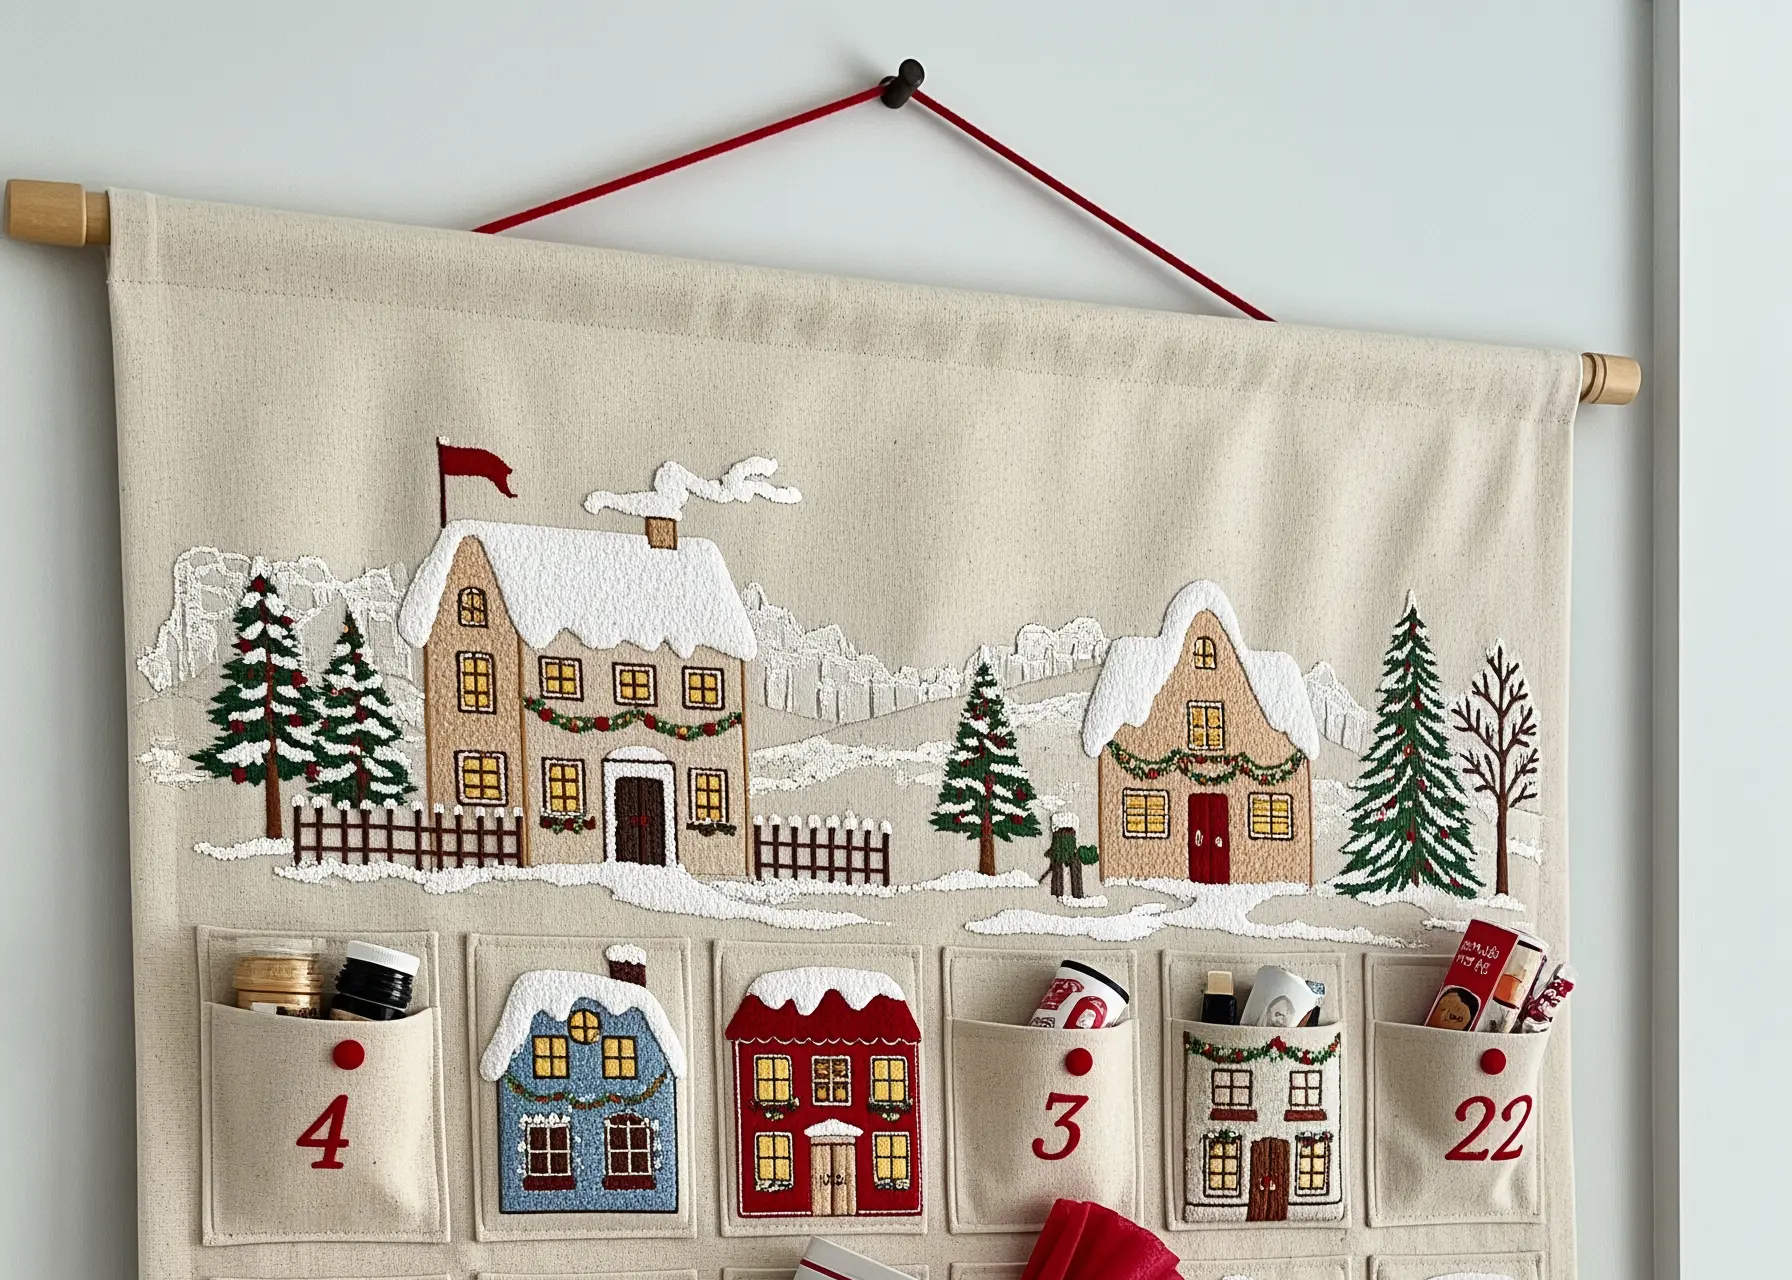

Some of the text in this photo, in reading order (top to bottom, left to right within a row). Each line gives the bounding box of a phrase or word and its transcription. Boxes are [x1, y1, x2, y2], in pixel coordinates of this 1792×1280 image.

[296, 1094, 350, 1169] 4
[1032, 1092, 1089, 1160] 3
[1445, 1094, 1532, 1161] 22
